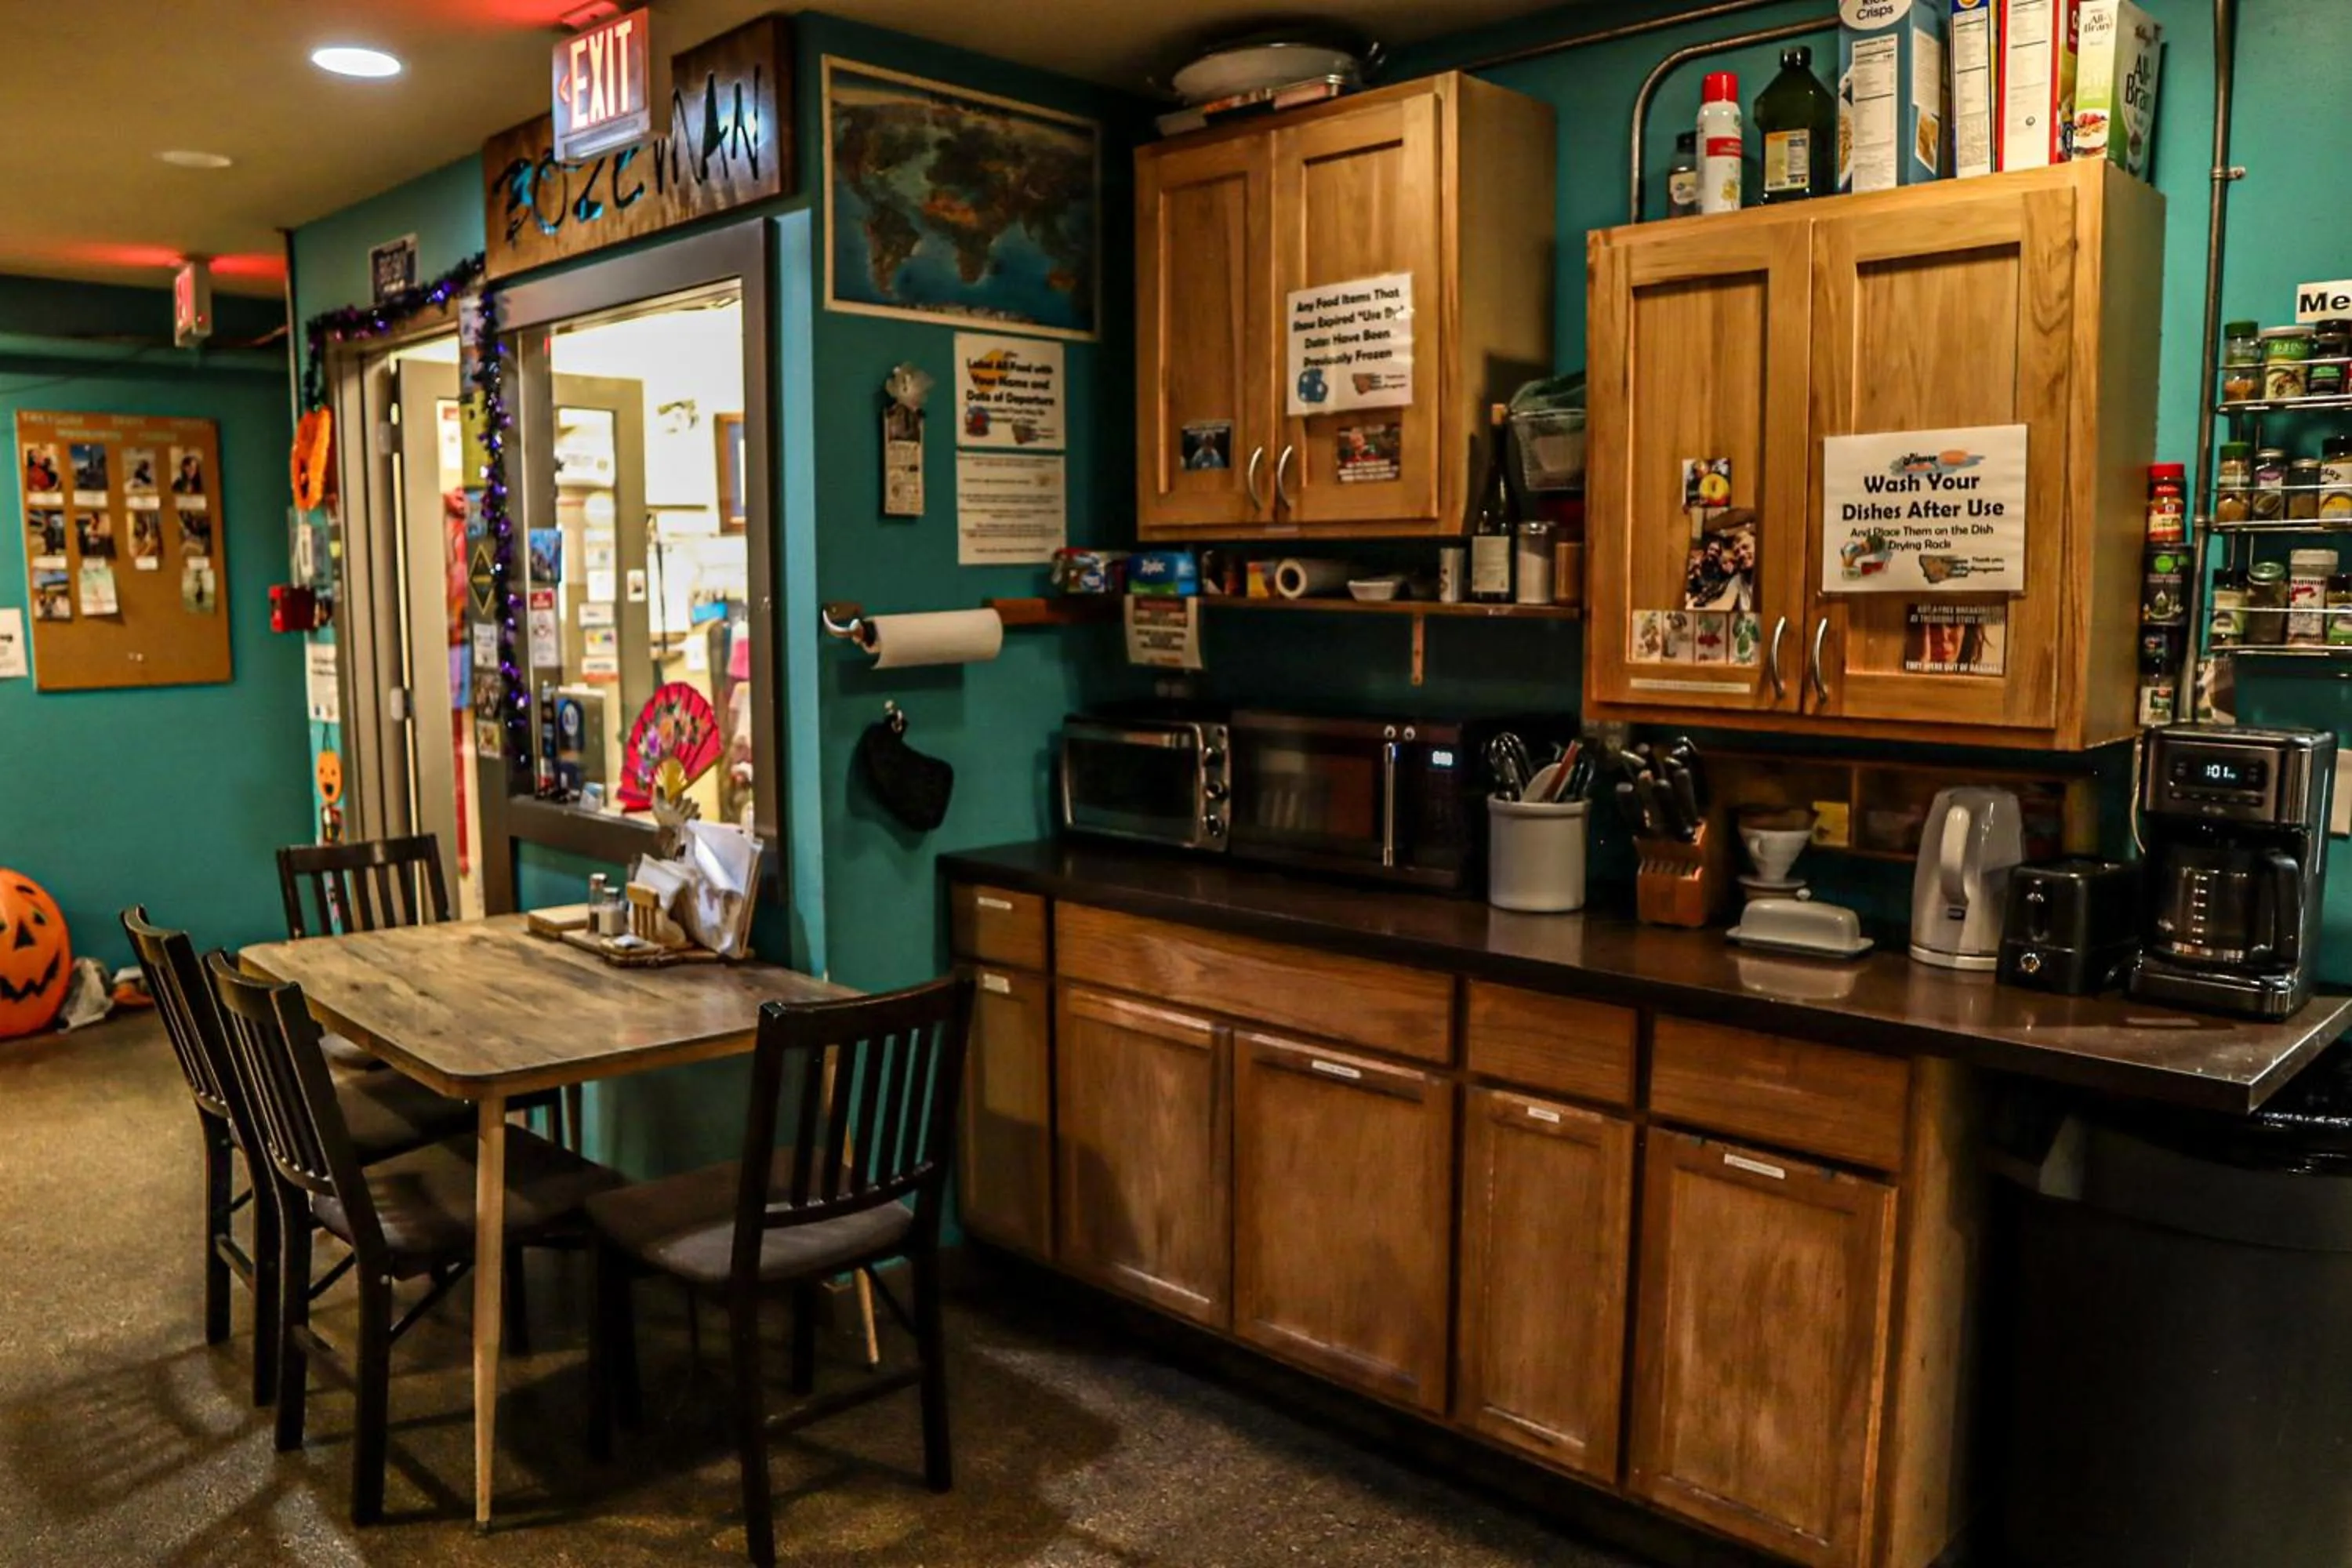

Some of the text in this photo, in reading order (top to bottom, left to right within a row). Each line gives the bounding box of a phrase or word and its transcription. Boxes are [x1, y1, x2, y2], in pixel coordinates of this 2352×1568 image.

[1856, 5, 1894, 21] Crisps
[570, 20, 632, 129] EXIT
[1297, 289, 1399, 312] Any Food Items That
[1319, 312, 1355, 328] Expired
[1334, 333, 1360, 345] Have
[1363, 330, 1390, 341] Been
[967, 359, 993, 369] Label
[1011, 362, 1032, 372] Food
[1305, 350, 1392, 367] Previously Frozen
[971, 373, 1050, 390] Your Name and
[967, 390, 1055, 405] Date of Departure
[1864, 472, 1981, 494] Wash Your
[1842, 499, 2005, 521] Dishes After Use
[1873, 528, 1900, 536] Place
[1904, 525, 1933, 536] Them
[1951, 525, 1969, 535] the
[1971, 524, 1994, 535] Dish
[1889, 539, 1951, 551] Drying Rack
